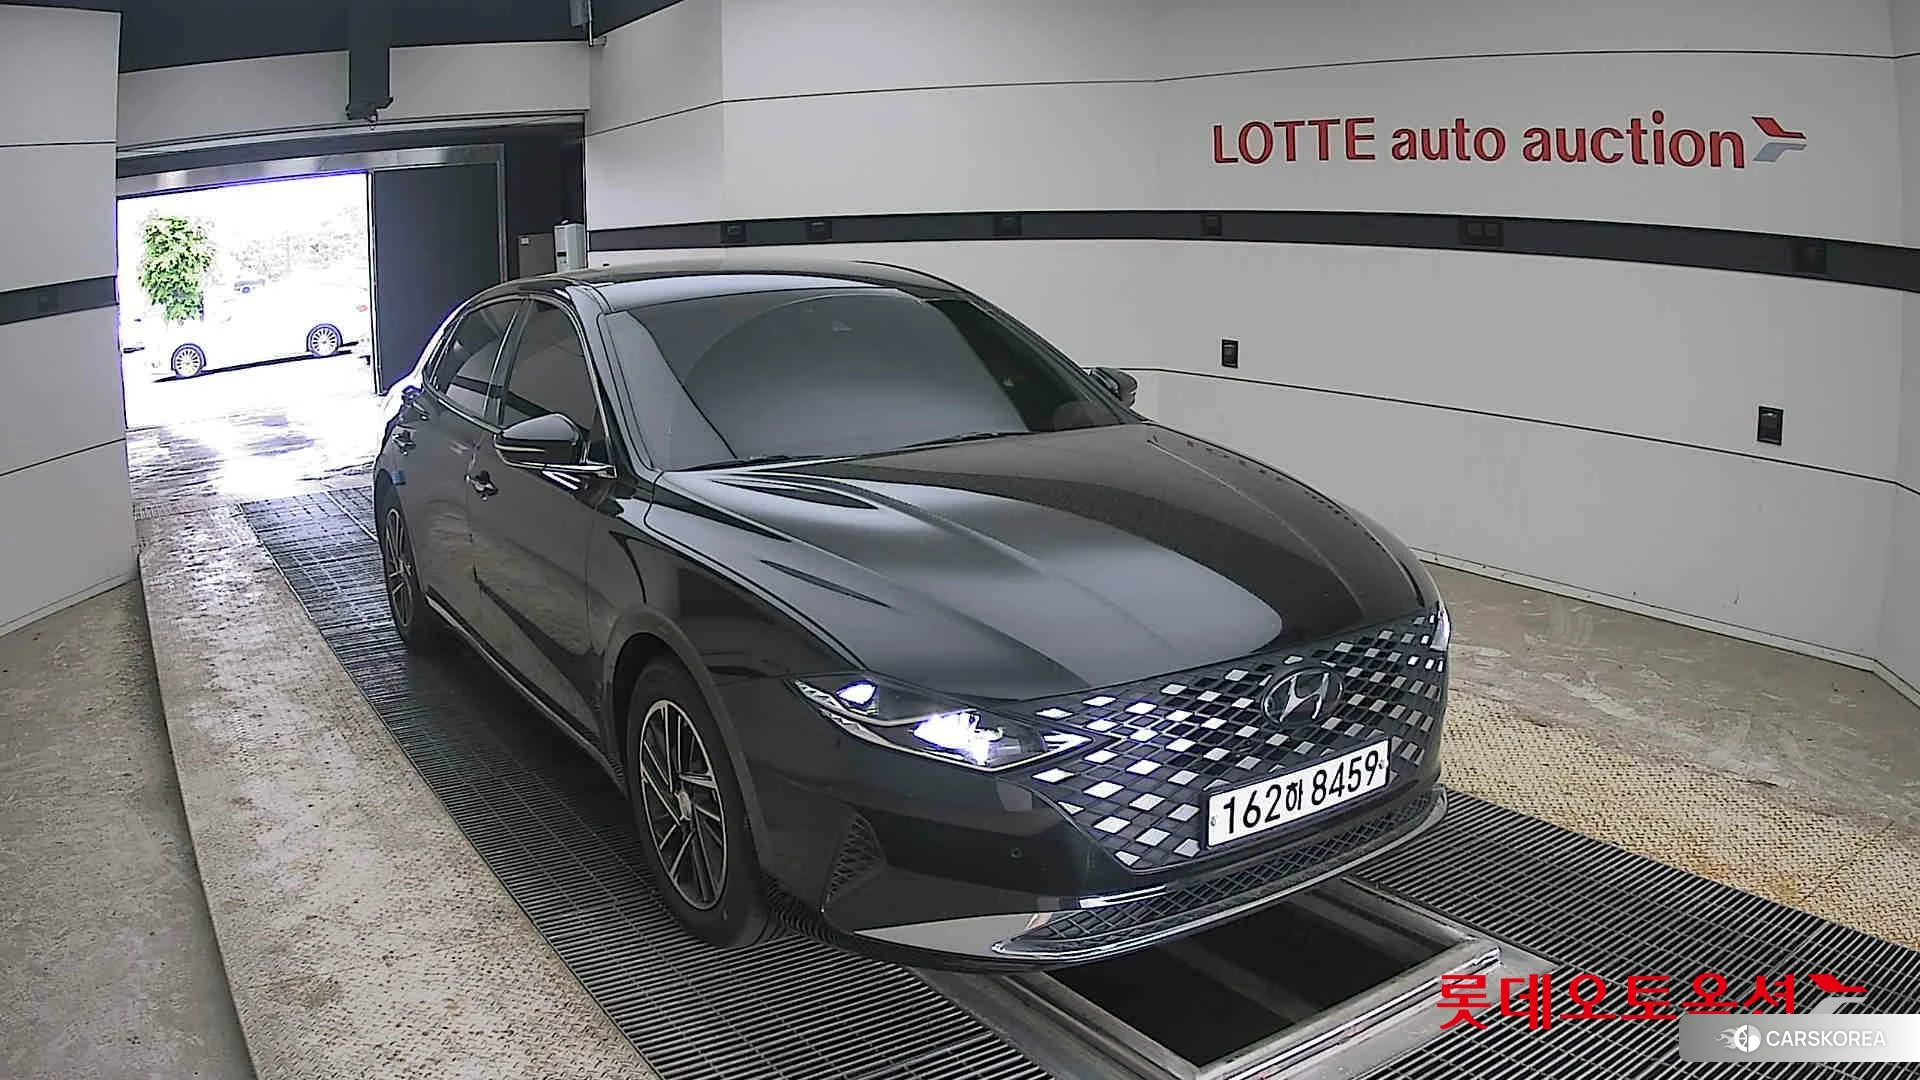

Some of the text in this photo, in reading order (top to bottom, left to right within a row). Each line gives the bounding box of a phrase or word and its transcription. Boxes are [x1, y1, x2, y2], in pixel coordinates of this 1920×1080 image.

[1211, 109, 1747, 169] LOTTE auto auction
[1223, 750, 1379, 834] 162하 8459
